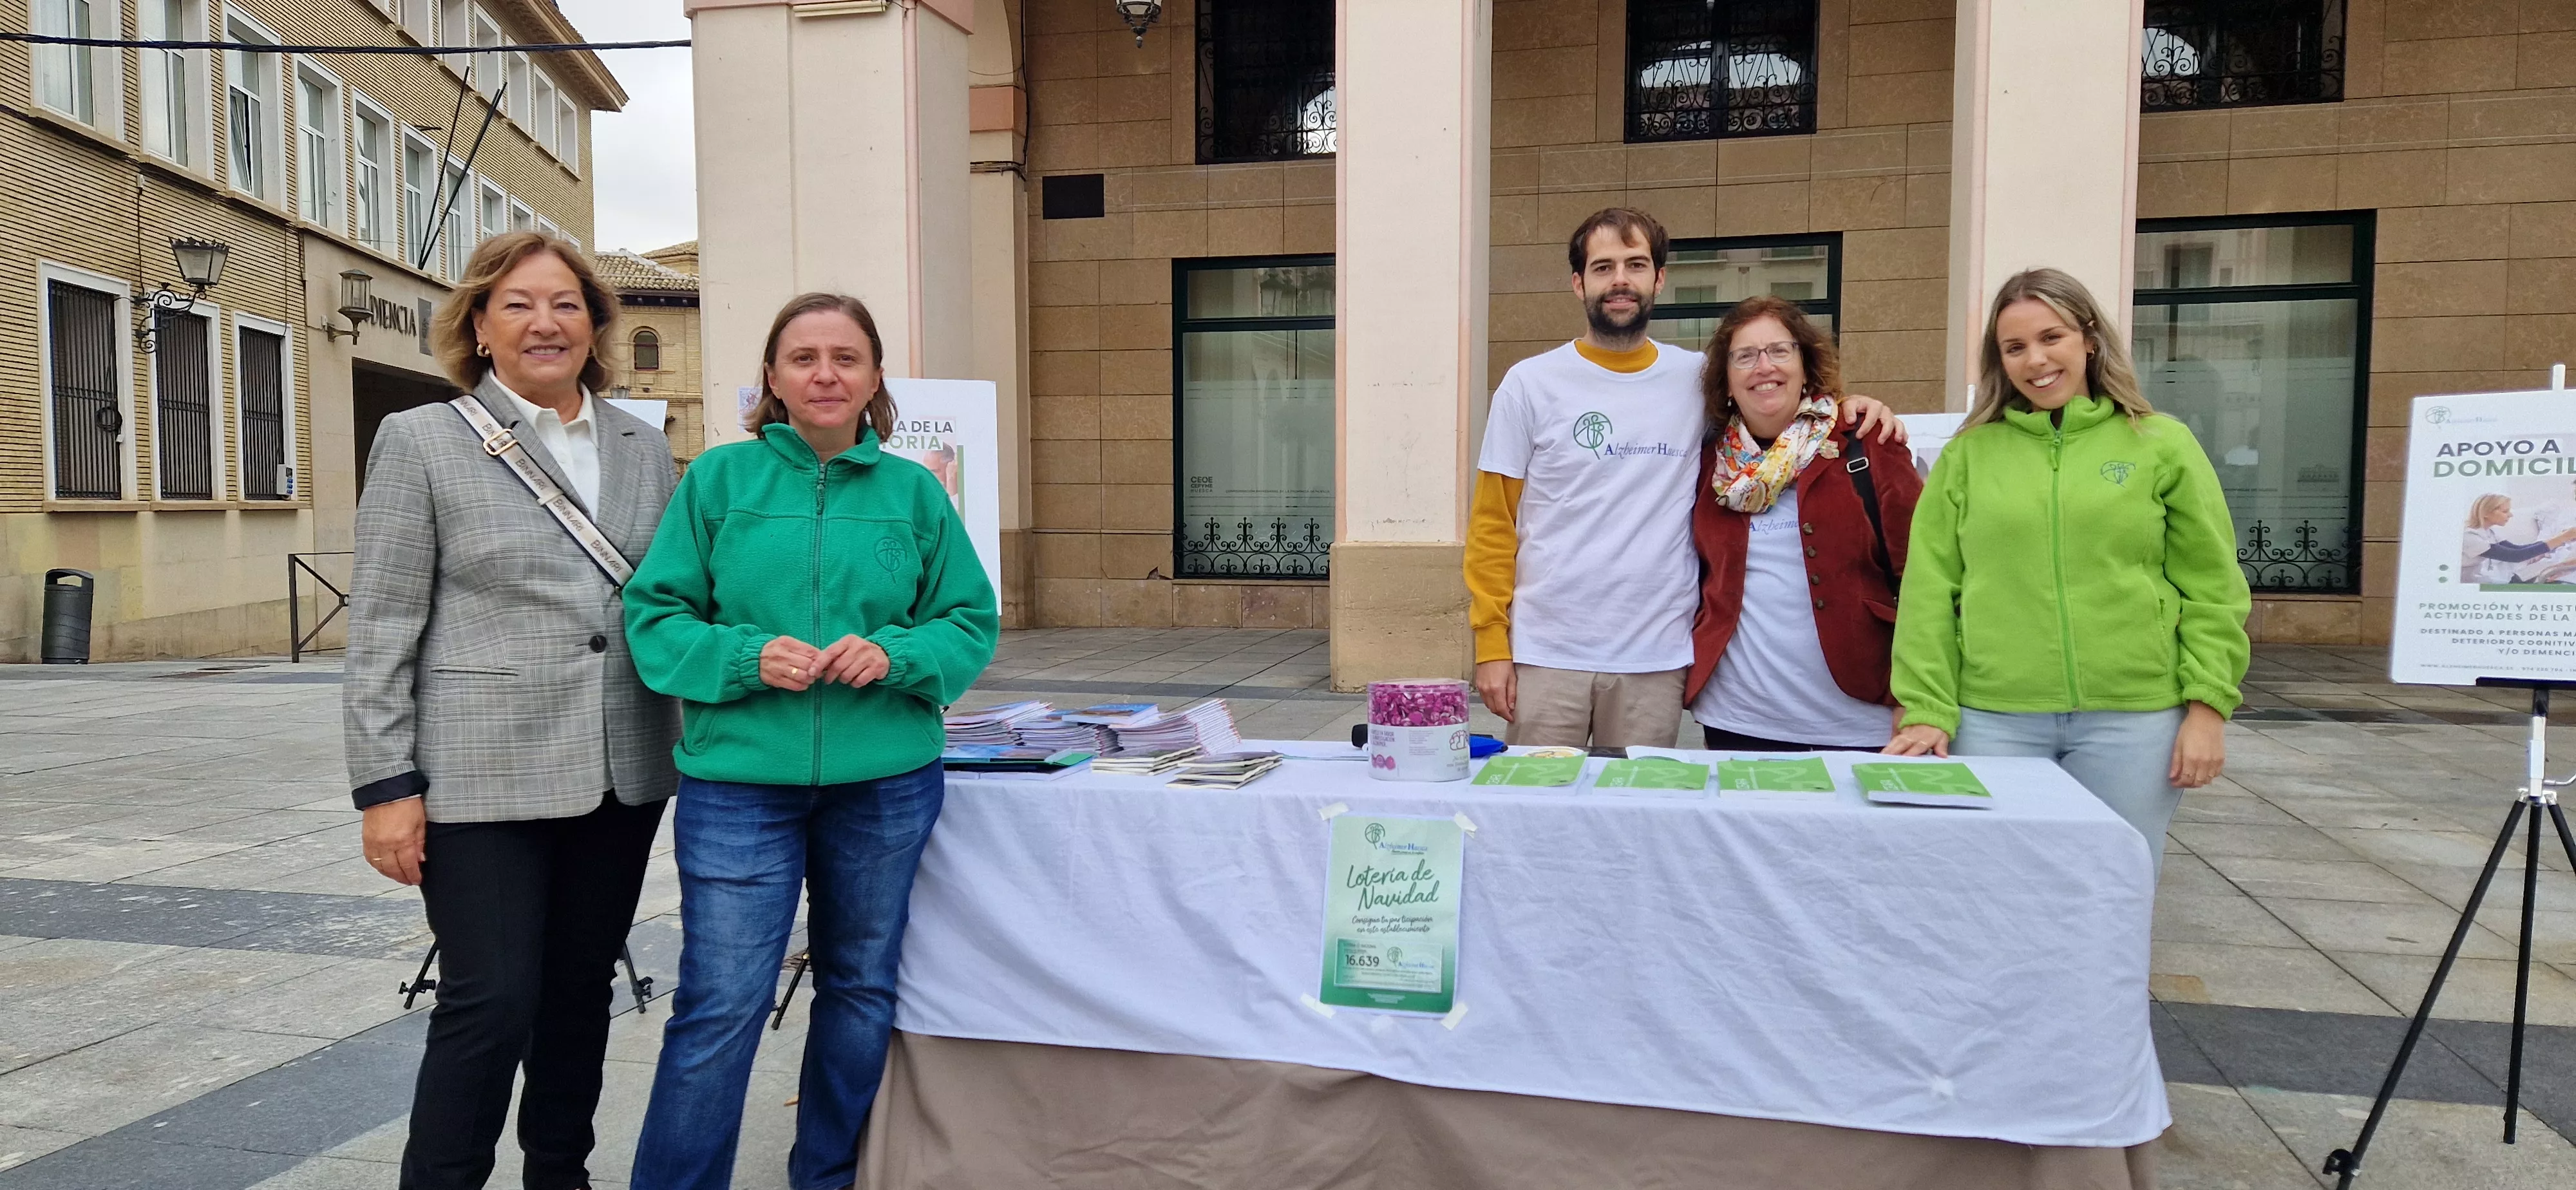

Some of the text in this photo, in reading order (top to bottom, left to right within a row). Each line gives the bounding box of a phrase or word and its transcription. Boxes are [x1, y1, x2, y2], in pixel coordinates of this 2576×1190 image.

[365, 295, 417, 337] DIENCIA
[893, 420, 953, 433] A DE LA
[882, 435, 941, 449] ORIA
[1604, 442, 1688, 459] Alzheimer Huesca
[2436, 439, 2561, 458] APOYO A
[2433, 457, 2576, 478] DOMICIL
[2419, 602, 2510, 611] PROMOCIÓN
[2423, 612, 2523, 620] ACTIVIDADES
[1347, 858, 1435, 889] Lotería de
[1358, 880, 1440, 911] Navidad
[1345, 954, 1379, 967] 16.639
